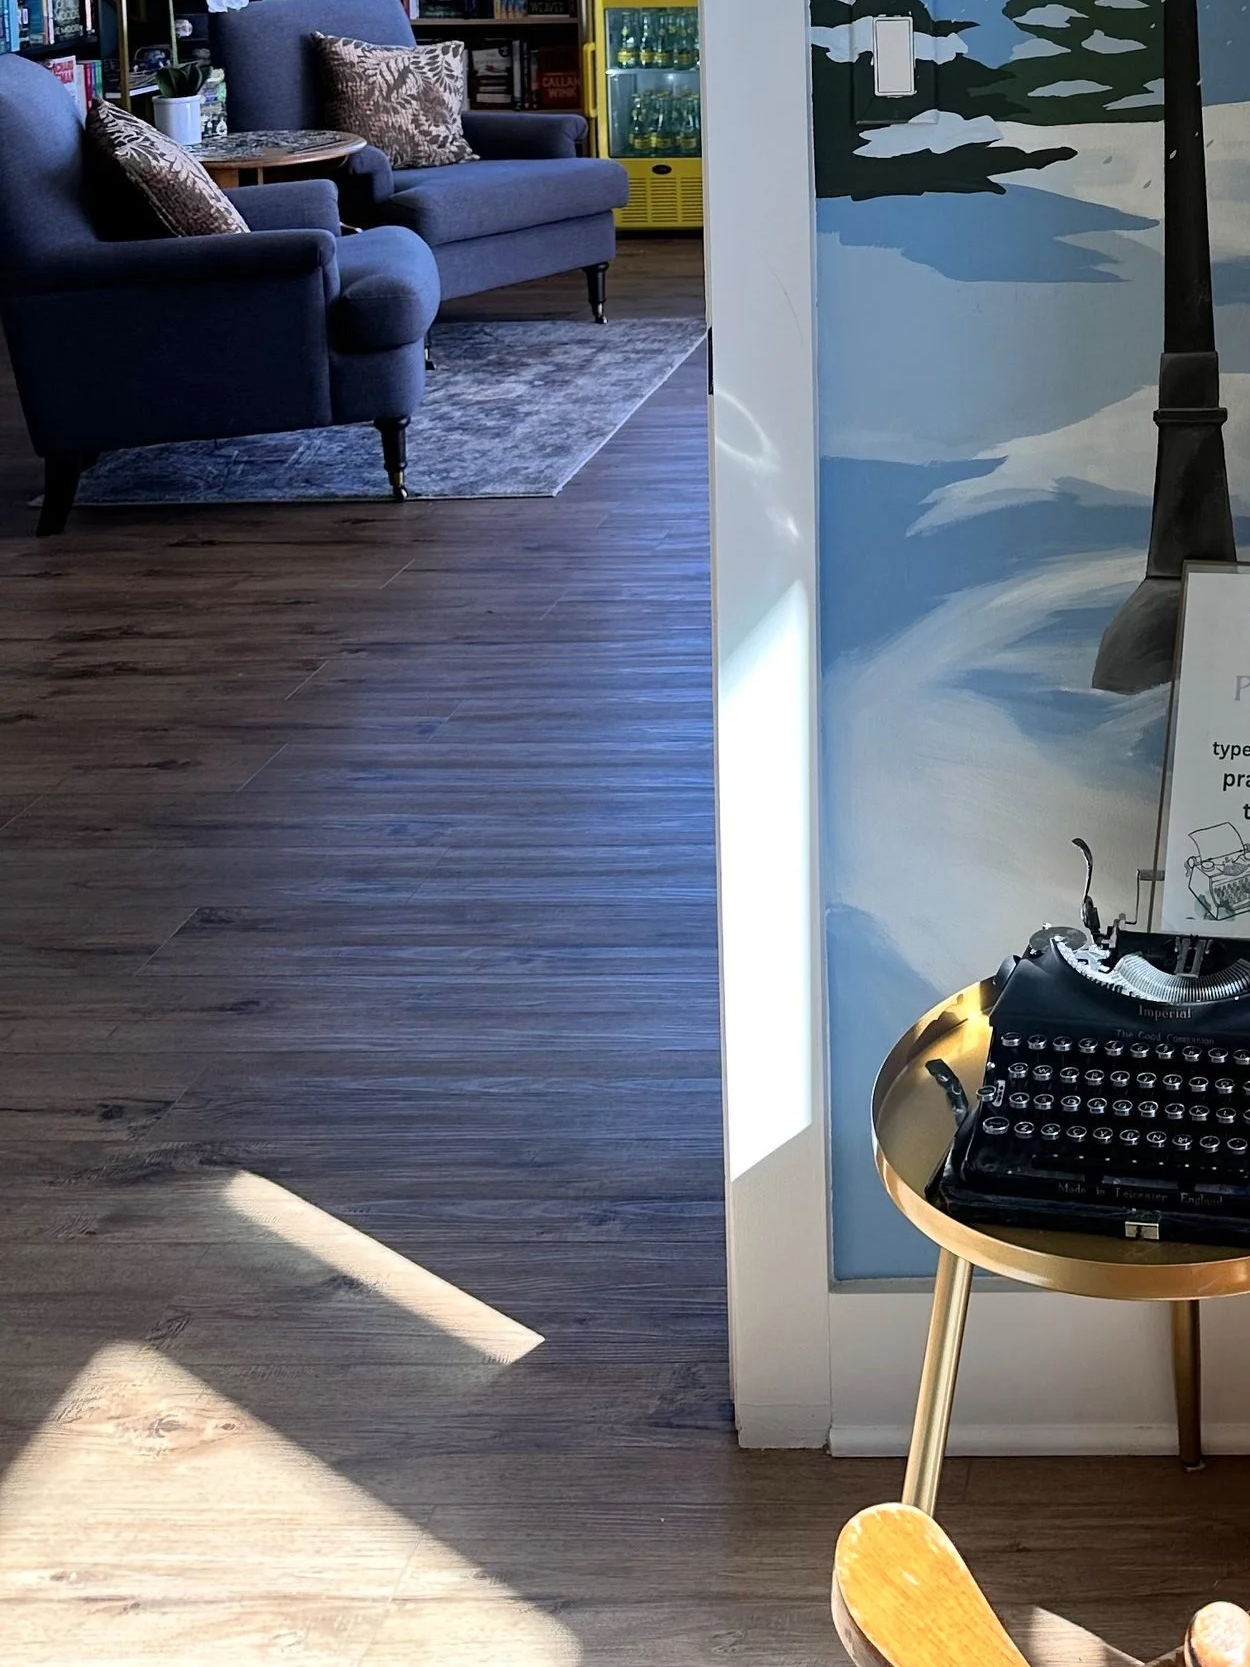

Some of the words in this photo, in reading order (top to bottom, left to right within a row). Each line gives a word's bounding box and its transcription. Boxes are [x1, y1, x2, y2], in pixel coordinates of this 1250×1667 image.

[1138, 1004, 1192, 1021] Imperial
[1057, 1182, 1088, 1195] Made
[1180, 1191, 1223, 1207] England
